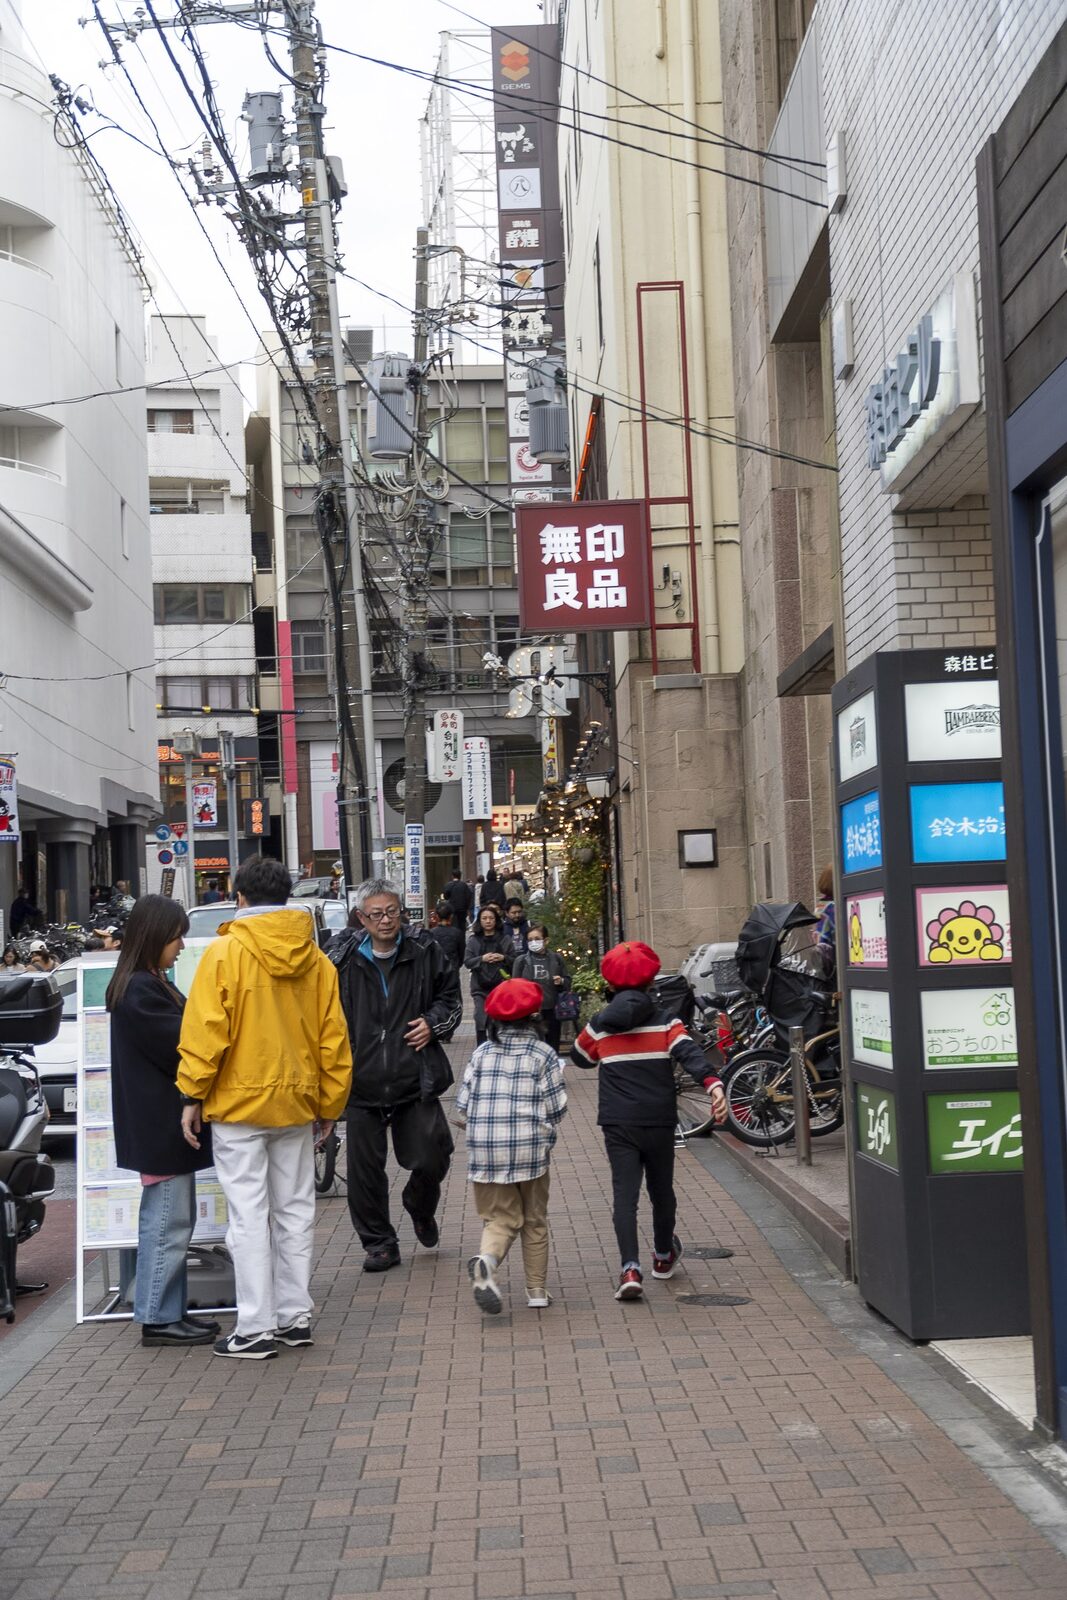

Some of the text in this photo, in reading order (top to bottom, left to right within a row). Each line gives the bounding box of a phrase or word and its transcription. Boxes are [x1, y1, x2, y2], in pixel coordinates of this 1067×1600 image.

[539, 523, 625, 565] 無印
[543, 568, 628, 611] 良品
[944, 653, 999, 673] 森住ビ
[928, 816, 1006, 838] 鈴木治
[927, 1034, 1014, 1054] おうちのド
